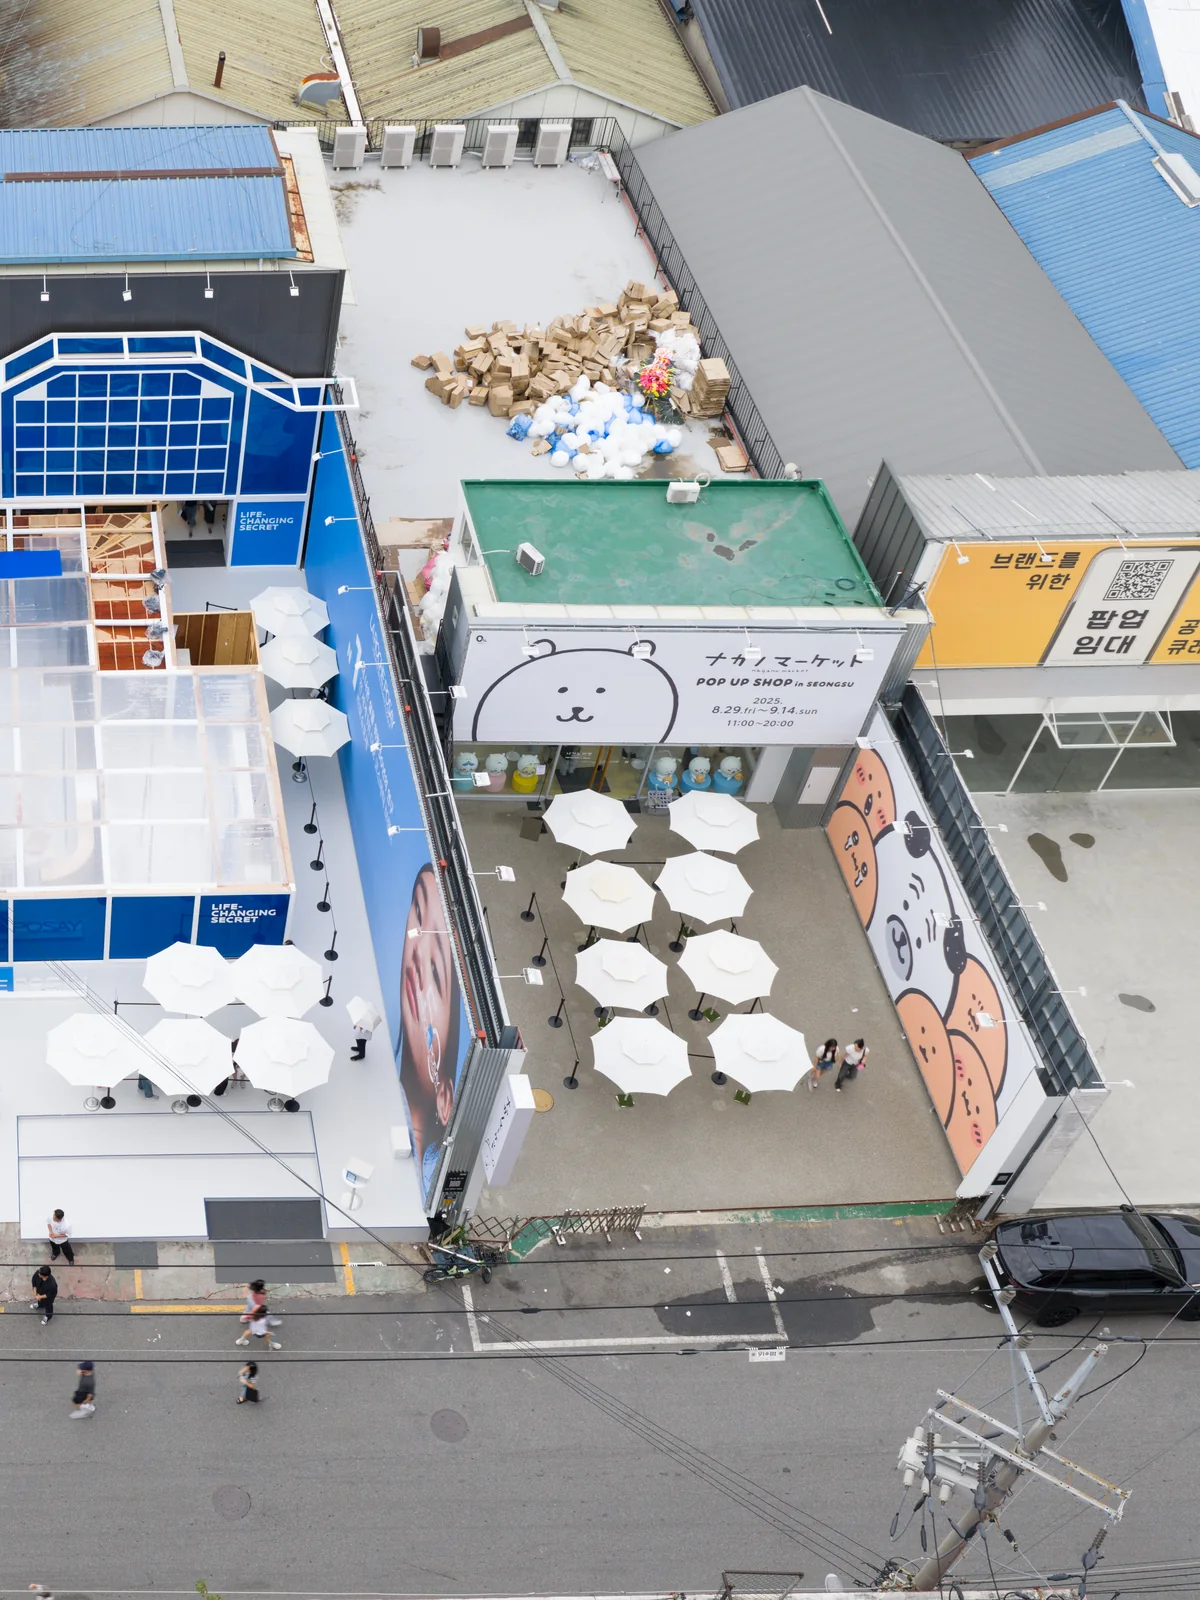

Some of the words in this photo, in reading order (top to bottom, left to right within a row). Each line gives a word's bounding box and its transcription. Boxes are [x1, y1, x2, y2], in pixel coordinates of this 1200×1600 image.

[240, 517, 294, 525] CHANGING
[990, 552, 1081, 569] 브랜드를
[1026, 573, 1071, 590] 위한
[1086, 609, 1150, 630] 팝업
[1073, 635, 1137, 655] 임대
[696, 677, 726, 687] POP
[730, 677, 750, 687] UP
[753, 677, 793, 687] SHOP
[753, 697, 783, 705] 2025.
[211, 903, 243, 911] LIFE-
[211, 909, 277, 917] CHANGING
[210, 916, 259, 924] SECRET
